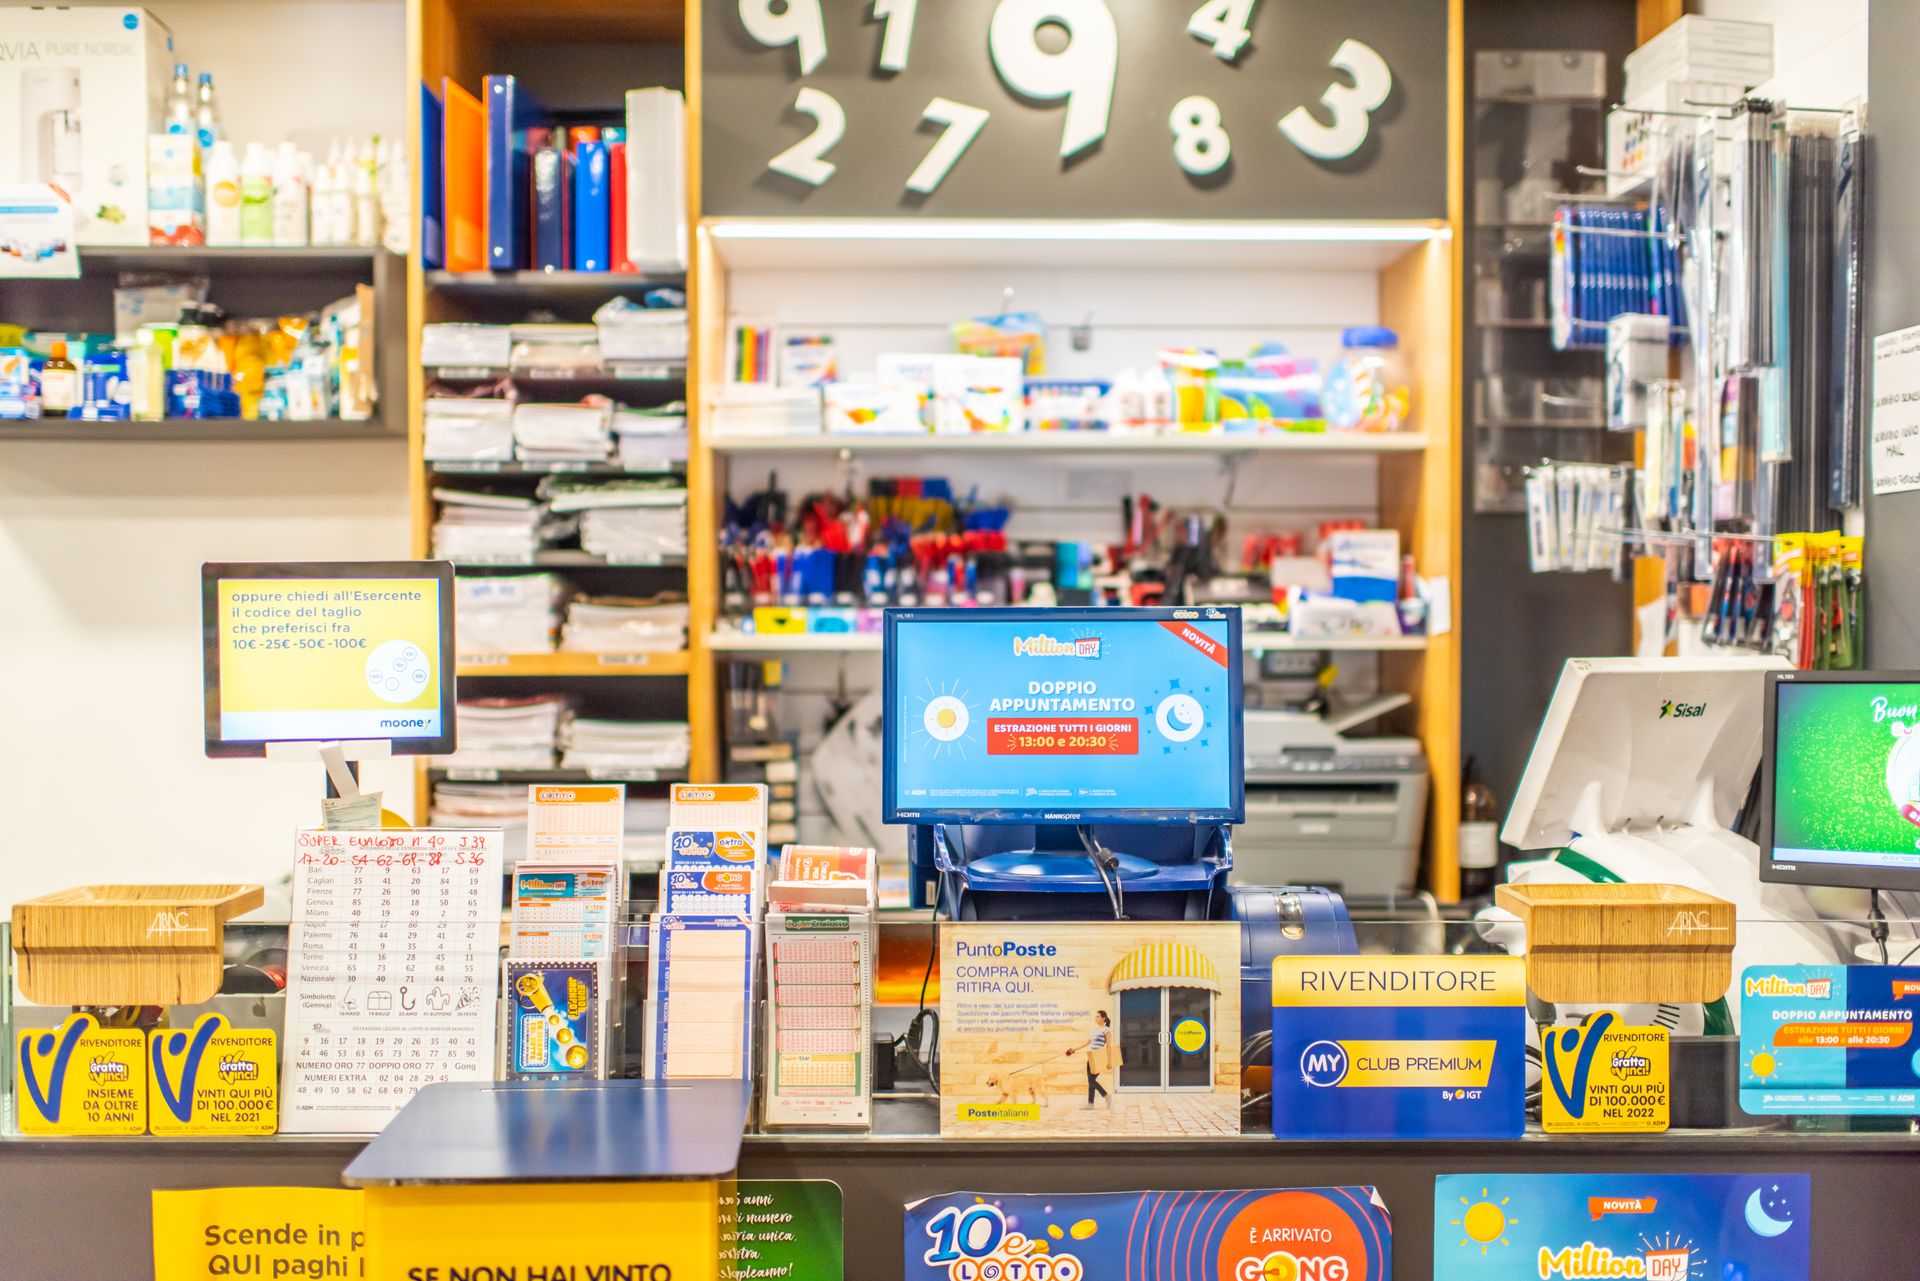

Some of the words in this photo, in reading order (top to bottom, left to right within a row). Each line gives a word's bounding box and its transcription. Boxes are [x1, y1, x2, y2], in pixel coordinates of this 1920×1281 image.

[0, 42, 40, 61] VIA
[990, 0, 1118, 158] 9
[1279, 38, 1392, 159] 3
[768, 87, 846, 186] 2
[1169, 95, 1231, 175] 8
[905, 97, 990, 193] 7
[232, 591, 282, 604] oppure
[287, 590, 329, 602] chiedi
[333, 590, 422, 602] all'Esercente
[232, 607, 239, 619] il
[244, 607, 291, 619] codice
[296, 607, 317, 619] del
[322, 607, 362, 619] taglio
[232, 622, 257, 635] che
[262, 622, 327, 635] preferisci
[332, 622, 351, 635] fra
[1014, 634, 1076, 657] Million
[1078, 642, 1097, 657] DAY
[1182, 627, 1217, 655] NOVITÀ
[1028, 681, 1097, 696] DOPPIO
[989, 698, 1136, 713] APPUNTAMENTO
[1674, 702, 1706, 718] Sisal
[1871, 696, 1918, 722] Buon
[380, 719, 432, 730] mooney
[994, 724, 1055, 733] ESTRAZIONE
[1058, 724, 1088, 733] TUTTI
[1091, 724, 1094, 733] I
[1095, 724, 1132, 733] GIORNI
[1018, 736, 1055, 748] 13:00
[1057, 739, 1066, 748] e
[1069, 736, 1107, 748] 20:30
[307, 877, 334, 886] Cagliari
[306, 909, 329, 917] Milano
[956, 941, 1057, 957] PuntoPoste
[303, 953, 324, 961] Torino
[301, 964, 329, 972] Venezia
[956, 966, 1019, 978] COMPRA
[1023, 966, 1079, 979] ONLINE,
[1301, 970, 1497, 991] RIVENDITORE
[1746, 975, 1807, 997] Million
[1810, 984, 1827, 995] DAY
[956, 981, 1002, 993] RITIRA
[1005, 981, 1034, 993] QUI.
[302, 1001, 332, 1009] (Genova)
[1773, 1011, 1816, 1020] DOPPIO
[1819, 1011, 1912, 1020] APPUNTAMENTO
[1784, 1026, 1838, 1034] ESTRAZIONE
[1841, 1026, 1867, 1034] TUTTI
[1873, 1026, 1904, 1034] GIORNI
[80, 1039, 141, 1048] RIVENDITORE
[211, 1037, 272, 1046] RIVENDITORE
[1604, 1034, 1665, 1042] RIVENDITORE
[1798, 1036, 1814, 1044] alle
[1816, 1036, 1839, 1044] 13:00
[1848, 1036, 1864, 1044] alle
[1866, 1036, 1890, 1044] 20:30
[90, 1062, 124, 1073] Gratta
[220, 1061, 253, 1072] Gratta
[296, 1062, 332, 1070] NUMERO
[334, 1062, 353, 1070] ORO
[369, 1062, 401, 1070] DOPPIO
[403, 1062, 421, 1070] ORO
[455, 1063, 476, 1071] Gong
[1308, 1055, 1341, 1072] MY
[1357, 1058, 1400, 1071] CLUB
[1406, 1058, 1482, 1071] PREMIUM
[1612, 1058, 1646, 1068] Gratta
[304, 1074, 337, 1082] NUMERI
[339, 1074, 367, 1082] EXTRA
[87, 1089, 134, 1098] INSIEME
[197, 1089, 225, 1098] VINTI
[230, 1089, 250, 1098] QUI
[255, 1086, 272, 1098] PIÙ
[1590, 1085, 1618, 1094] VINTI
[1622, 1085, 1643, 1094] QUI
[1647, 1082, 1665, 1094] PIÙ
[1442, 1091, 1453, 1101] By
[1466, 1091, 1482, 1099] IGT
[1590, 1096, 1601, 1106] DI
[84, 1101, 100, 1110] DA
[105, 1101, 138, 1110] OLTRE
[197, 1100, 209, 1110] DI
[88, 1113, 100, 1122] 10
[104, 1113, 134, 1122] ANNI
[211, 1113, 231, 1122] NEL
[235, 1113, 259, 1122] 2021
[968, 1108, 1029, 1118] Posteitaliane
[1604, 1109, 1623, 1118] NEL
[1627, 1109, 1654, 1118] 2022
[744, 1194, 774, 1206] anni
[1603, 1199, 1642, 1210] NOVITÀ
[746, 1212, 793, 1224] numero
[204, 1223, 308, 1246] Scende
[319, 1224, 340, 1246] in
[925, 1205, 1006, 1264] 10
[1250, 1228, 1256, 1244] È
[1262, 1228, 1332, 1244] ARRIVATO
[1540, 1242, 1645, 1279] Million
[1652, 1258, 1681, 1277] DAY
[208, 1255, 260, 1276] QUI
[273, 1255, 348, 1279] paghi
[408, 1267, 439, 1281] SE
[450, 1266, 516, 1281] NON
[586, 1264, 672, 1281] VINTO
